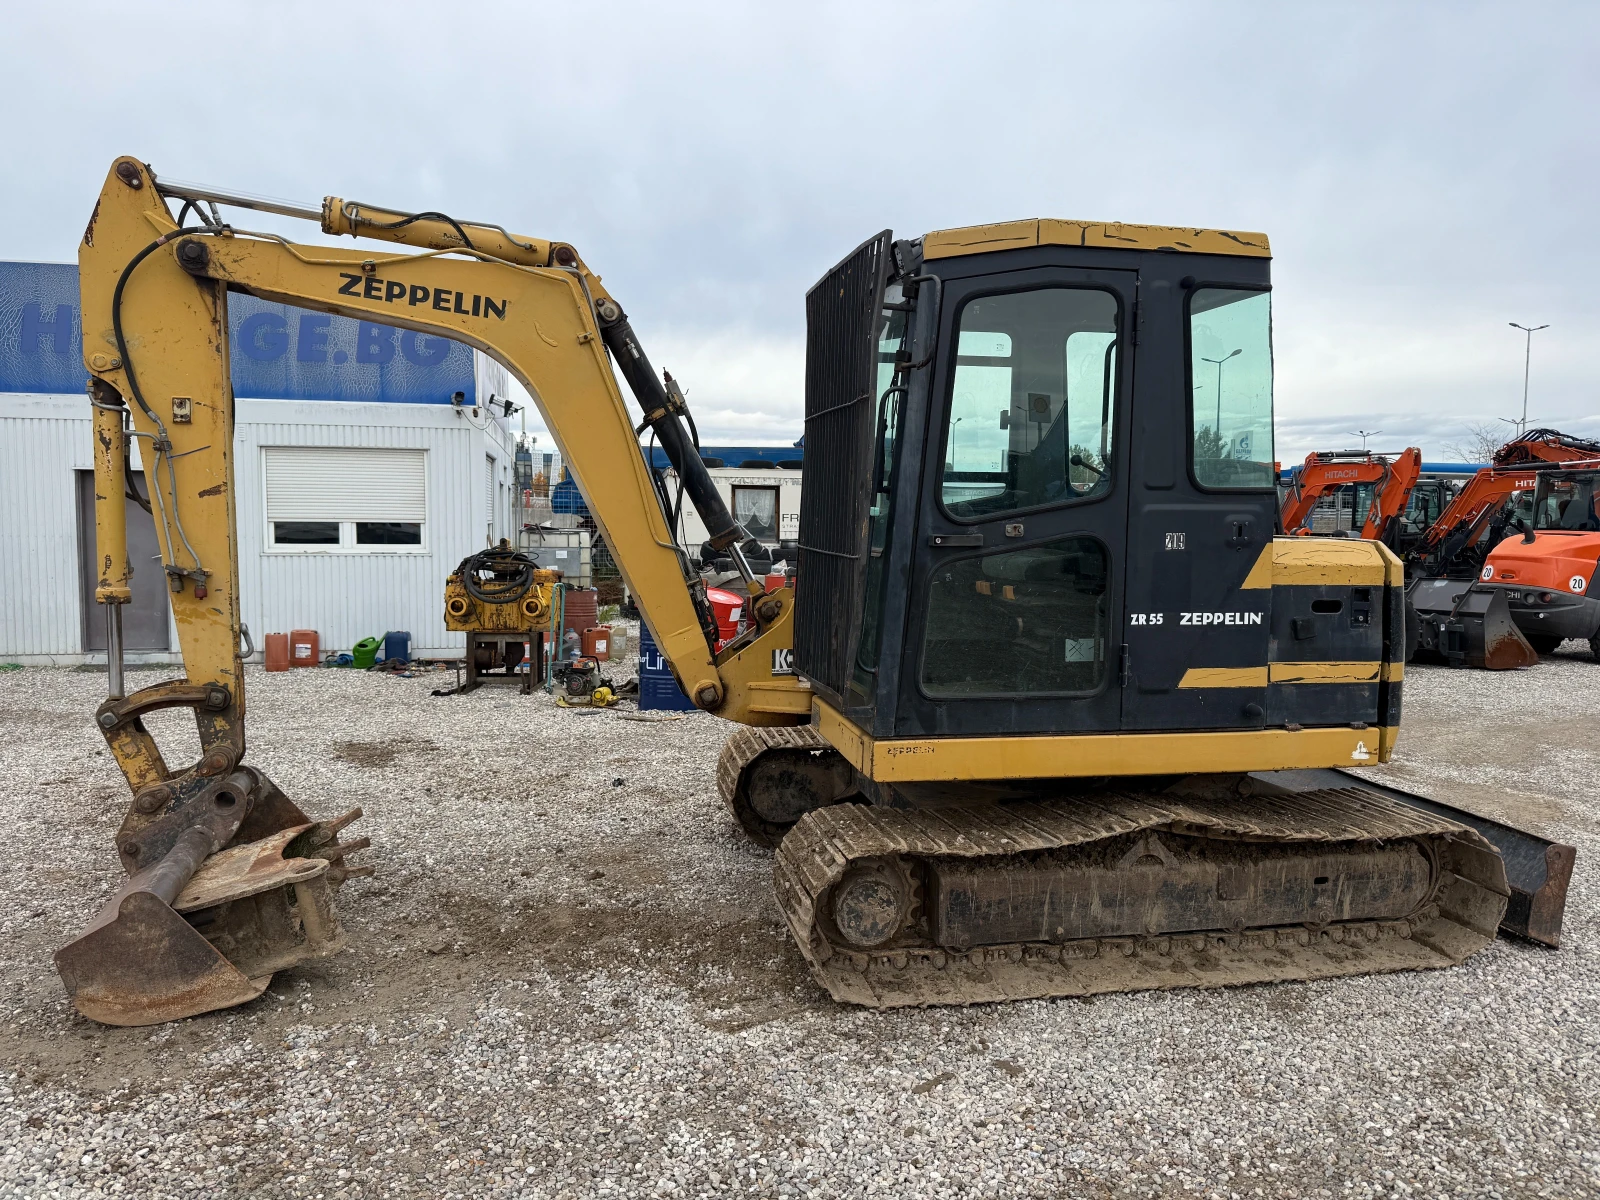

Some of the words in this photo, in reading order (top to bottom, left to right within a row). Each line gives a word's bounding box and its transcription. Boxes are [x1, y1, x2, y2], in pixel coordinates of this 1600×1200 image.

[338, 272, 507, 321] ZEPPELIN
[20, 303, 73, 353] H
[1324, 469, 1358, 479] HITACHI
[1483, 567, 1492, 578] 20
[1572, 578, 1583, 589] 20
[1130, 613, 1147, 625] ZR
[1149, 613, 1164, 625] 55
[1179, 612, 1263, 625] ZEPPELIN
